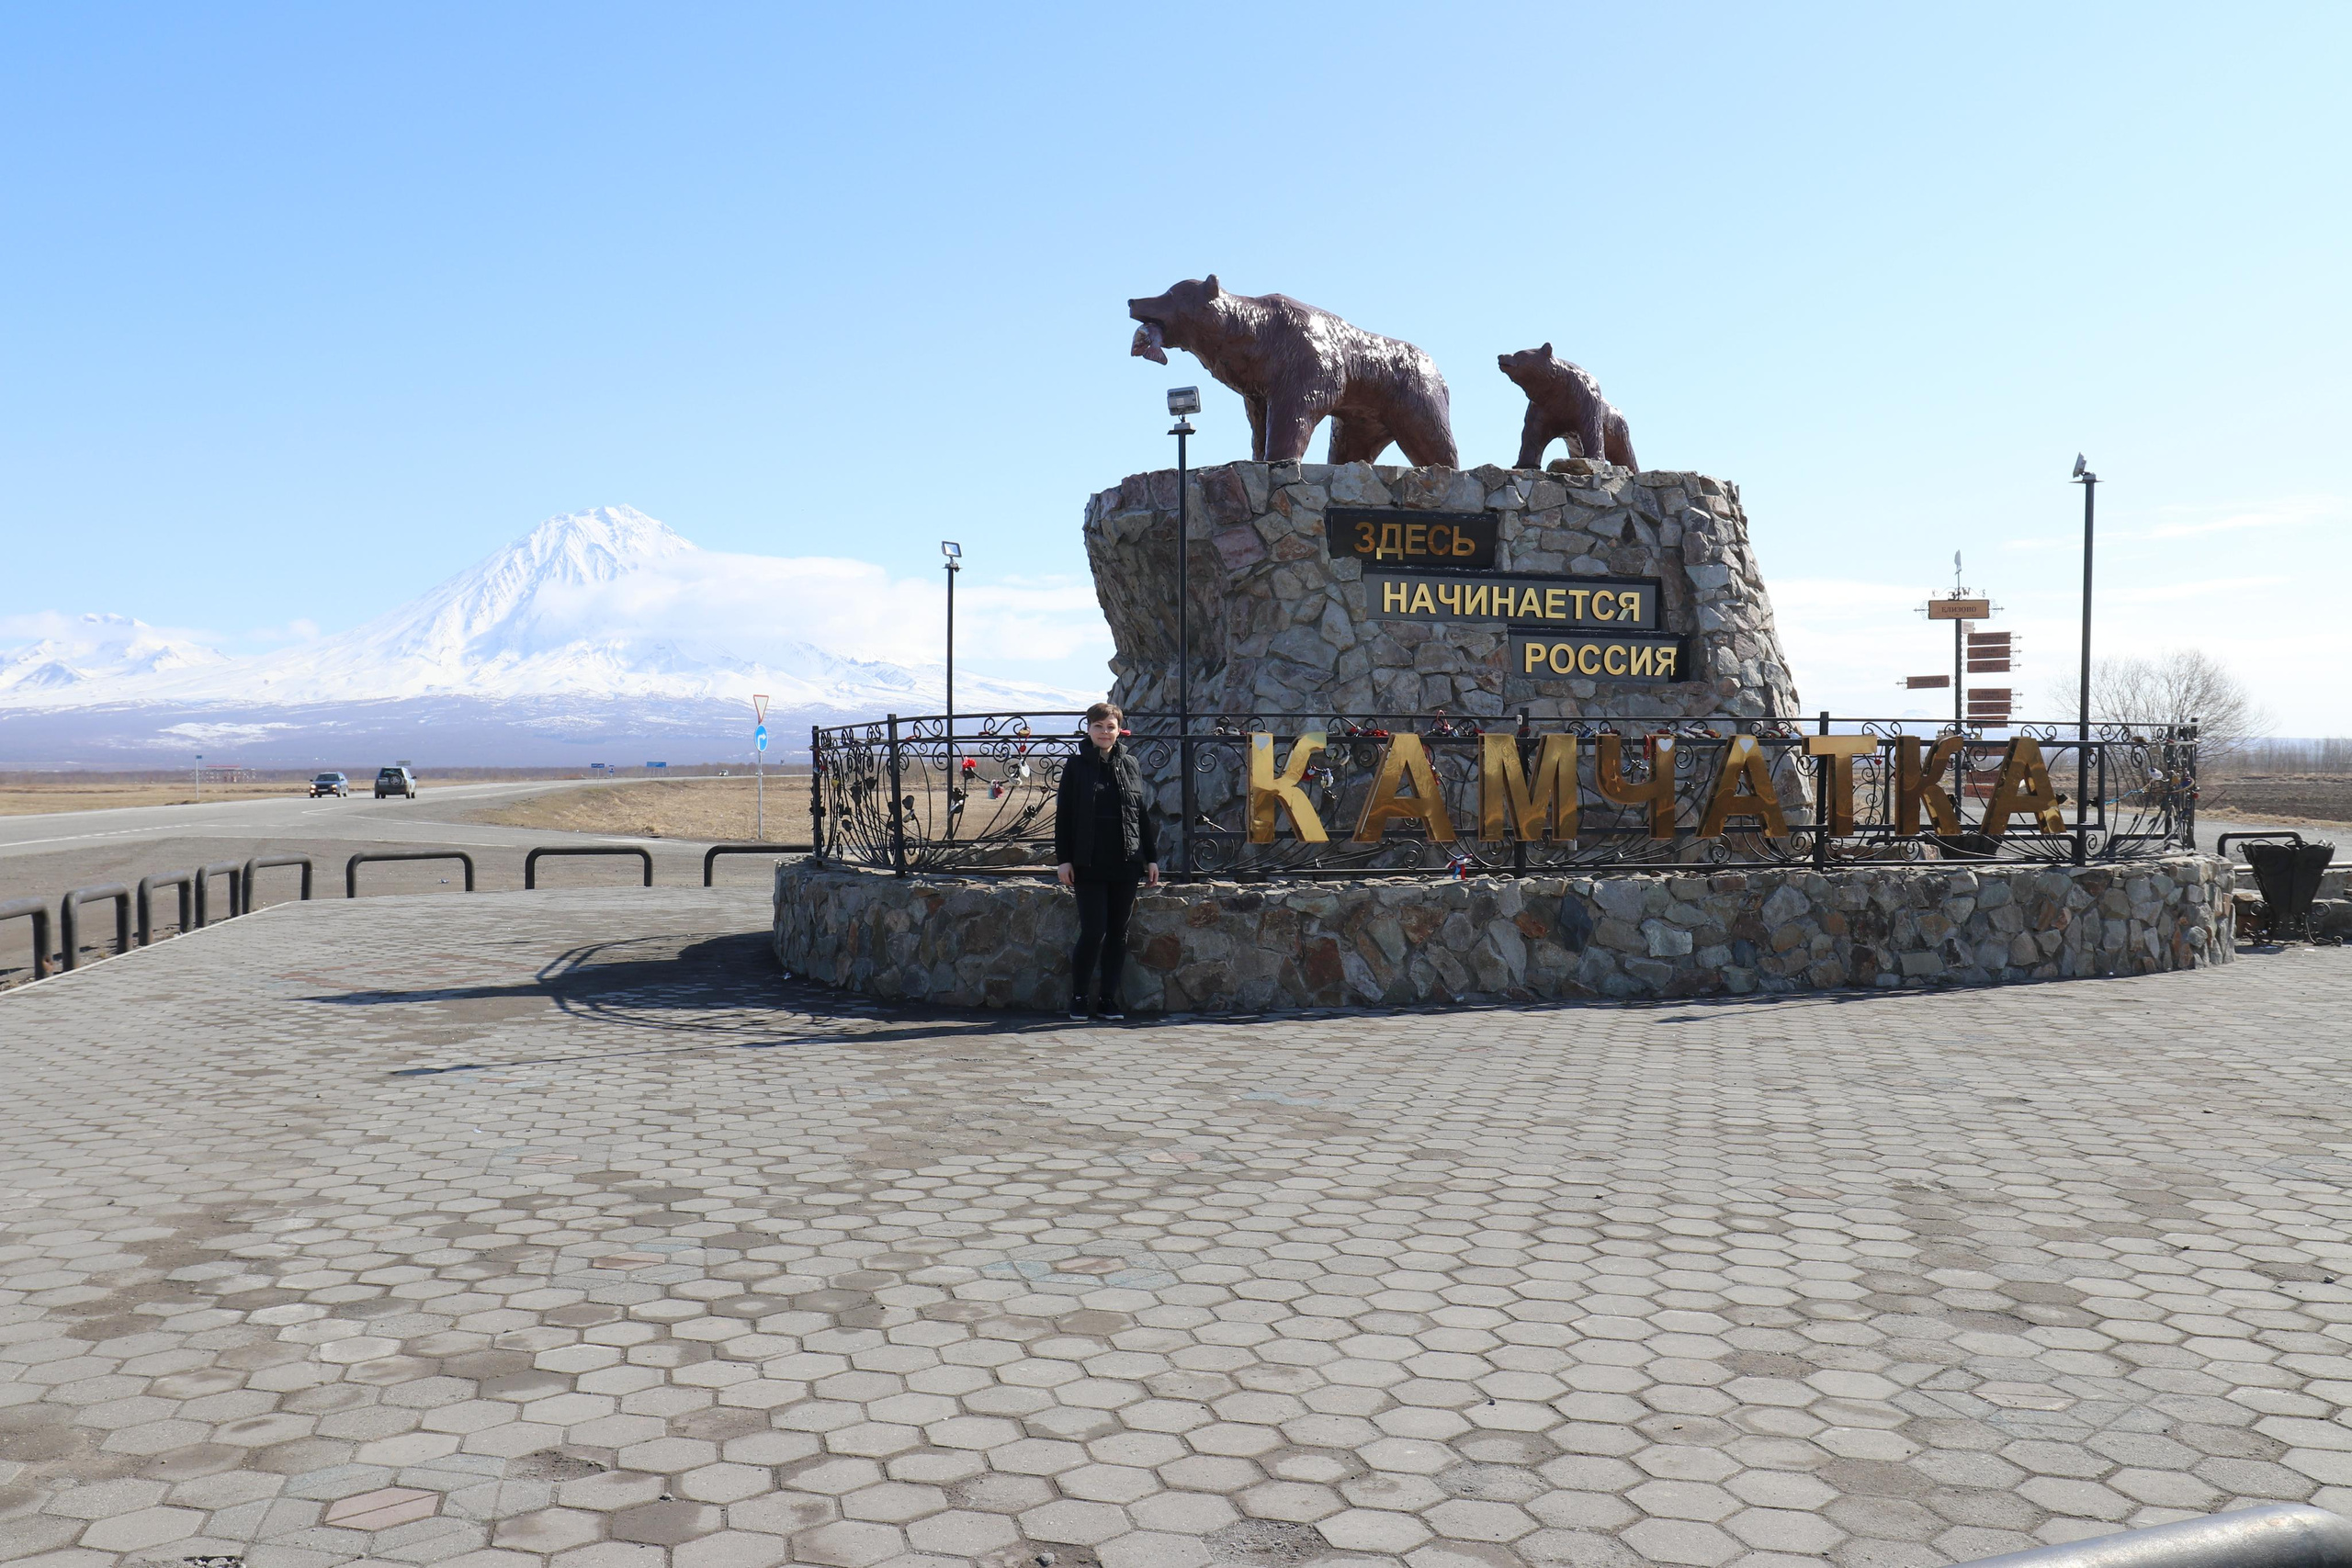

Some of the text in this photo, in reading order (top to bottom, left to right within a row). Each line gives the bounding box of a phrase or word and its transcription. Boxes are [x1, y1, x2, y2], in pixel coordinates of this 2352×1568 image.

[1354, 521, 1476, 559] ЗДЕСЬ
[1383, 581, 1641, 622] НАЧИНАЕТСЯ
[1524, 642, 1678, 676] РОССИЯ
[1247, 731, 2066, 843] КАМЧАТКА
